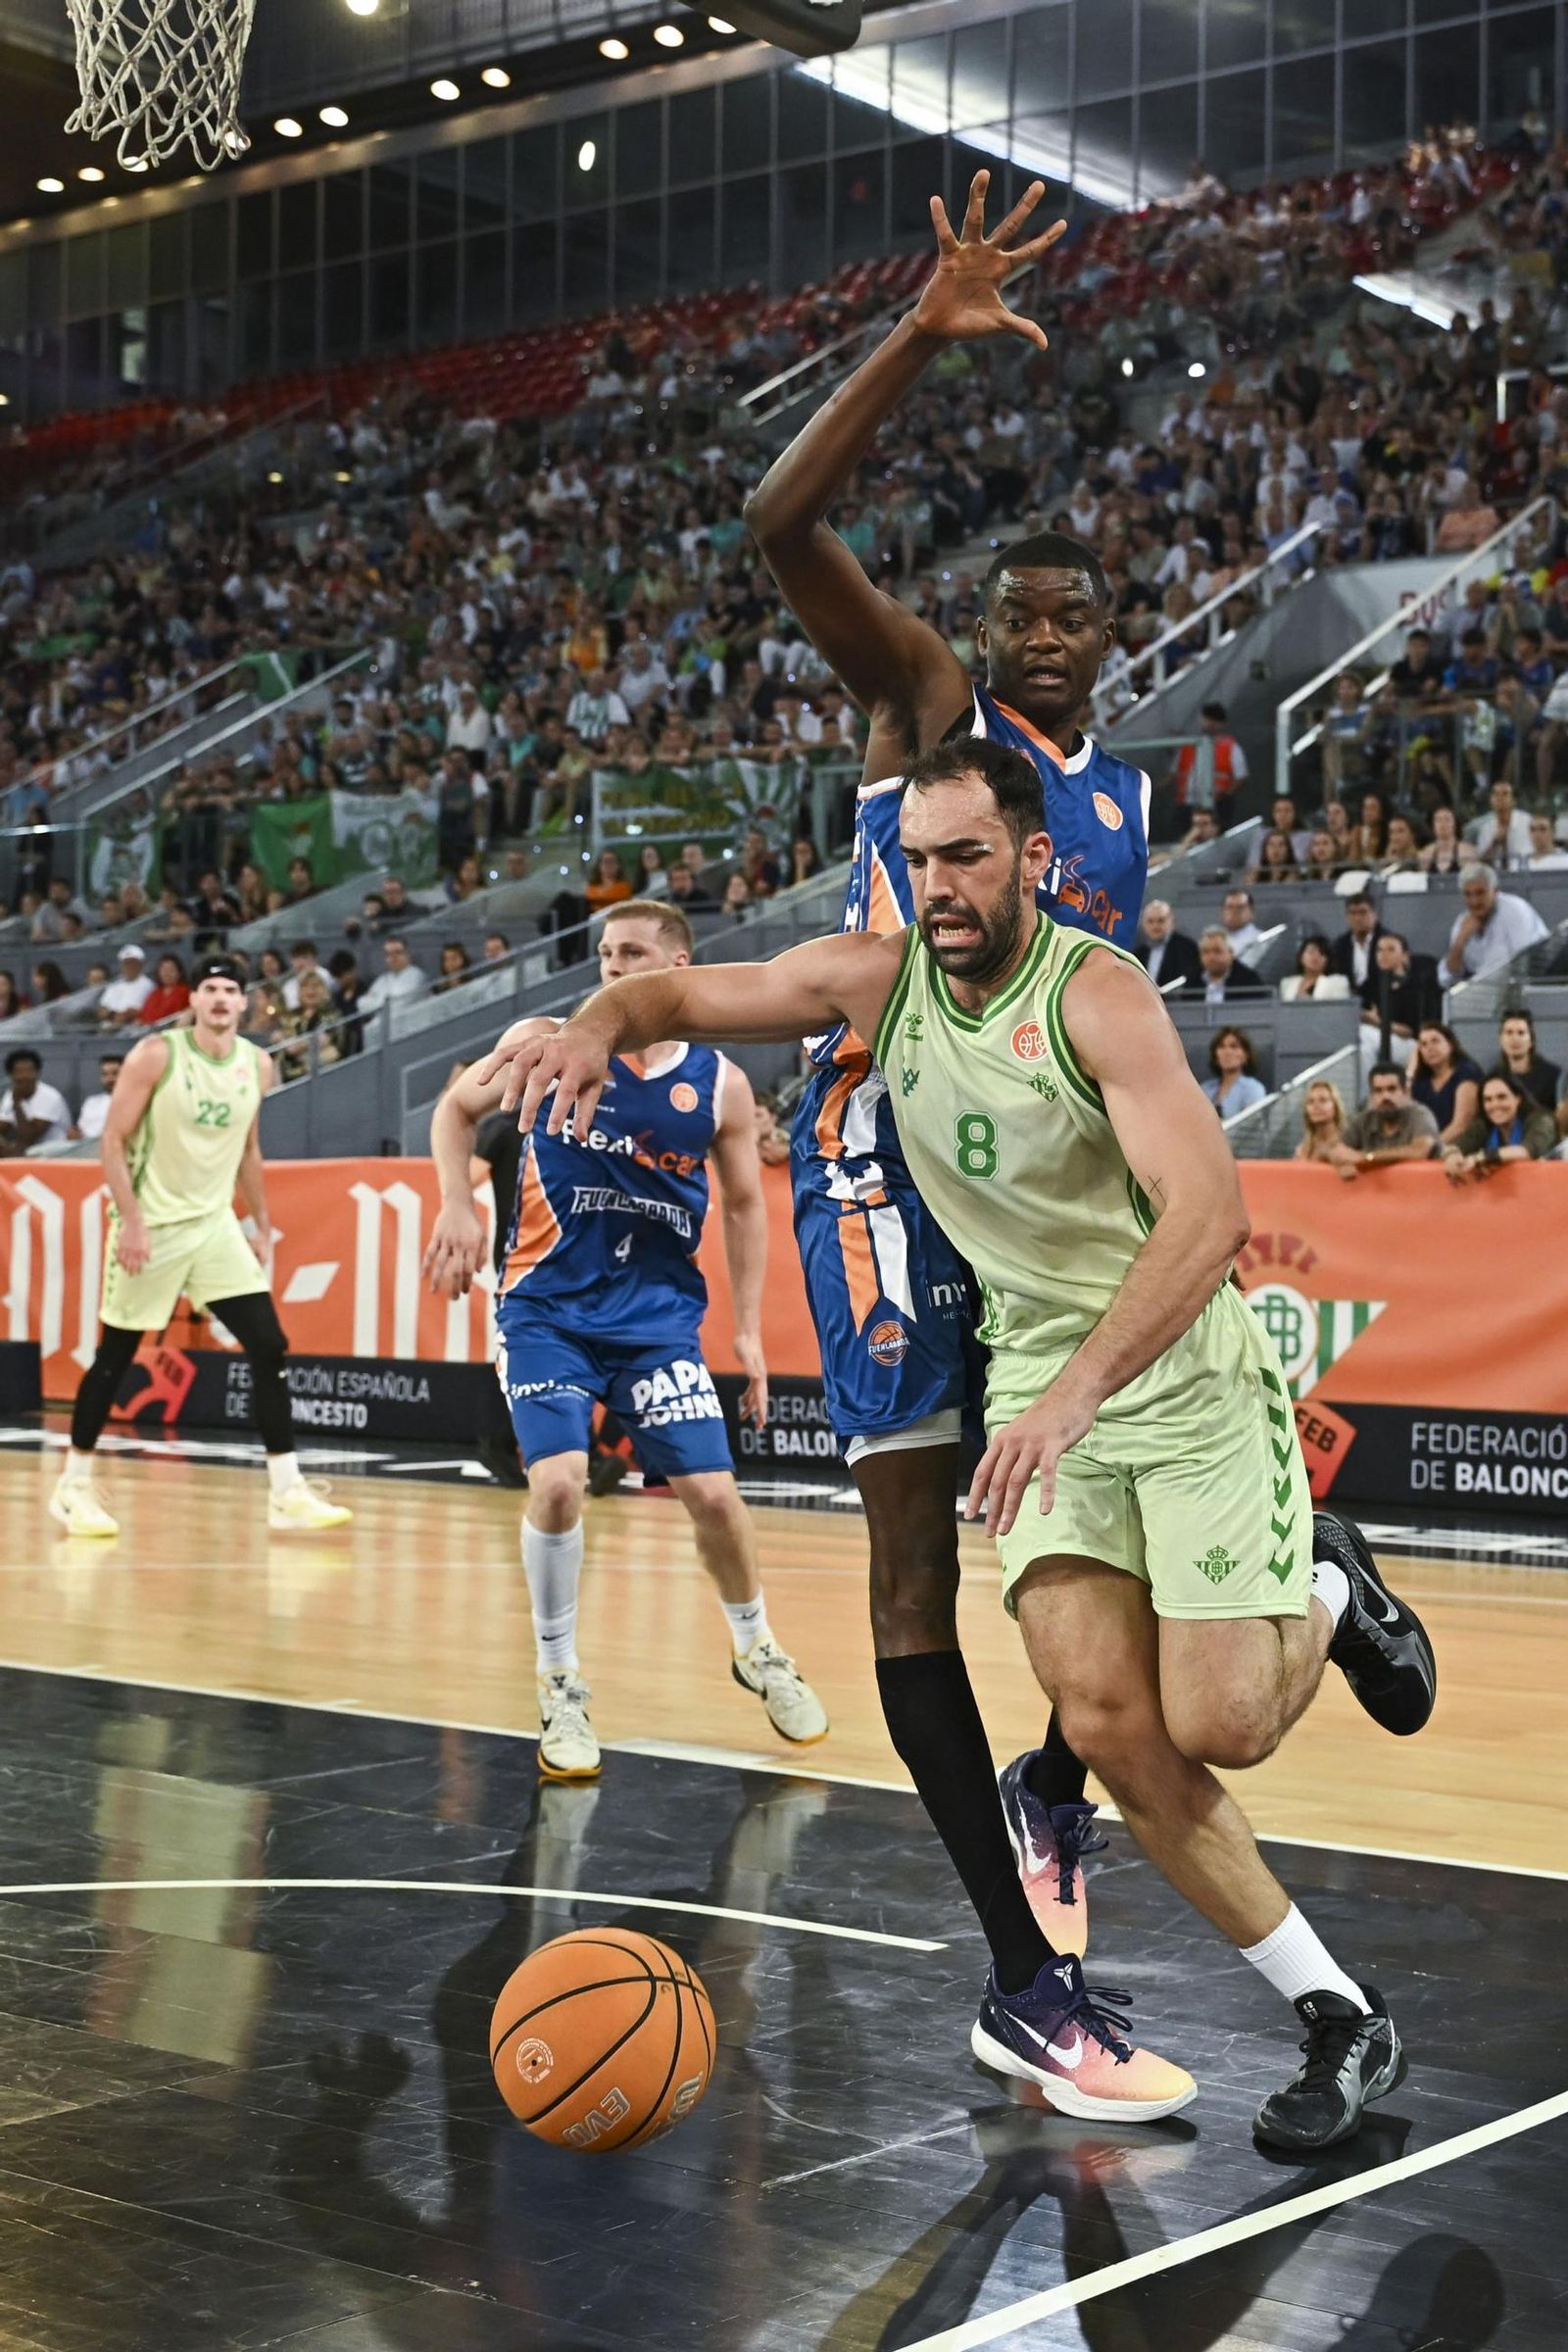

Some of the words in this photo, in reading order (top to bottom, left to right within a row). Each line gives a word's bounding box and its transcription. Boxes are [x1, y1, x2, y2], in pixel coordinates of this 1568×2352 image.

[196, 1100, 231, 1128] 22
[955, 1109, 1001, 1181] 8
[613, 1232, 634, 1263] 4
[337, 1368, 431, 1403] ESPAÑOLA
[630, 1358, 716, 1415] PAPA
[225, 1391, 250, 1420] DE
[638, 1393, 725, 1429] JOHNS
[739, 1426, 769, 1456] DE
[1294, 1406, 1338, 1452] FEB
[1410, 1421, 1568, 1461] FEDERACIÓ
[1409, 1457, 1447, 1491] DE
[1454, 1460, 1568, 1499] BALONC
[562, 2085, 631, 2148] EVO
